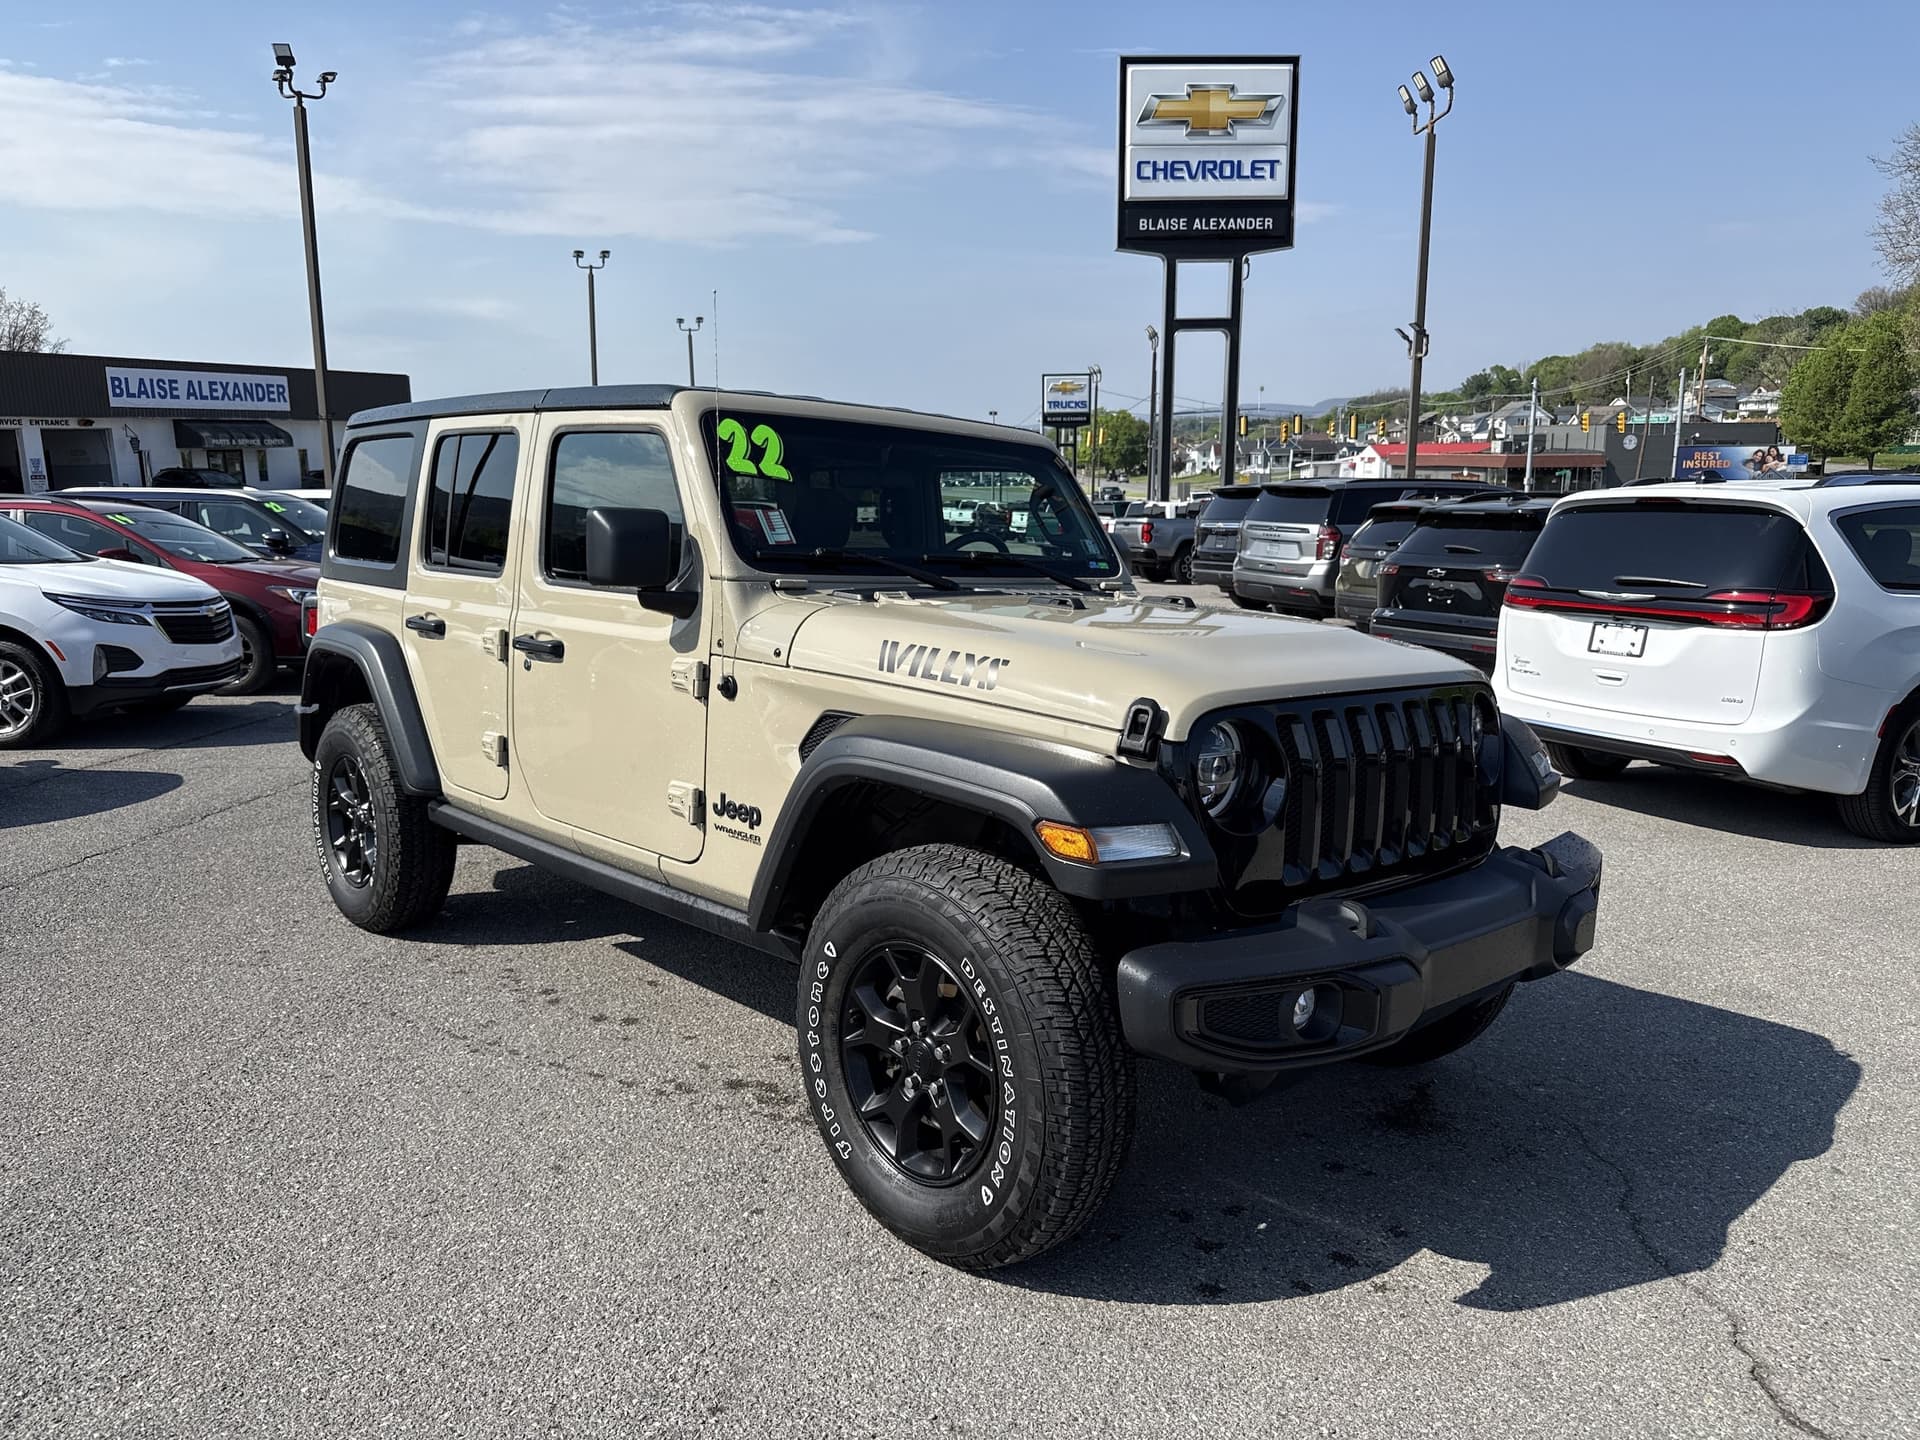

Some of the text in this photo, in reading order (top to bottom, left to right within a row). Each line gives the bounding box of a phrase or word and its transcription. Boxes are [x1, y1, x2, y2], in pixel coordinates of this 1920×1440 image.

[1136, 159, 1281, 181] CHEVROLET
[1139, 217, 1273, 231] BLAISE ALEXANDER
[110, 376, 288, 403] BLAISE ALEXANDER
[1047, 400, 1088, 409] TRUCKS
[29, 418, 70, 426] ENTRANCE
[717, 418, 792, 482] 22
[1694, 451, 1721, 460] REST
[1682, 460, 1732, 469] INSURED
[878, 639, 1011, 691] WILLYS
[712, 791, 762, 830] Jeep
[713, 823, 762, 844] WRANGLER
[960, 957, 1016, 1189] DESTINATION
